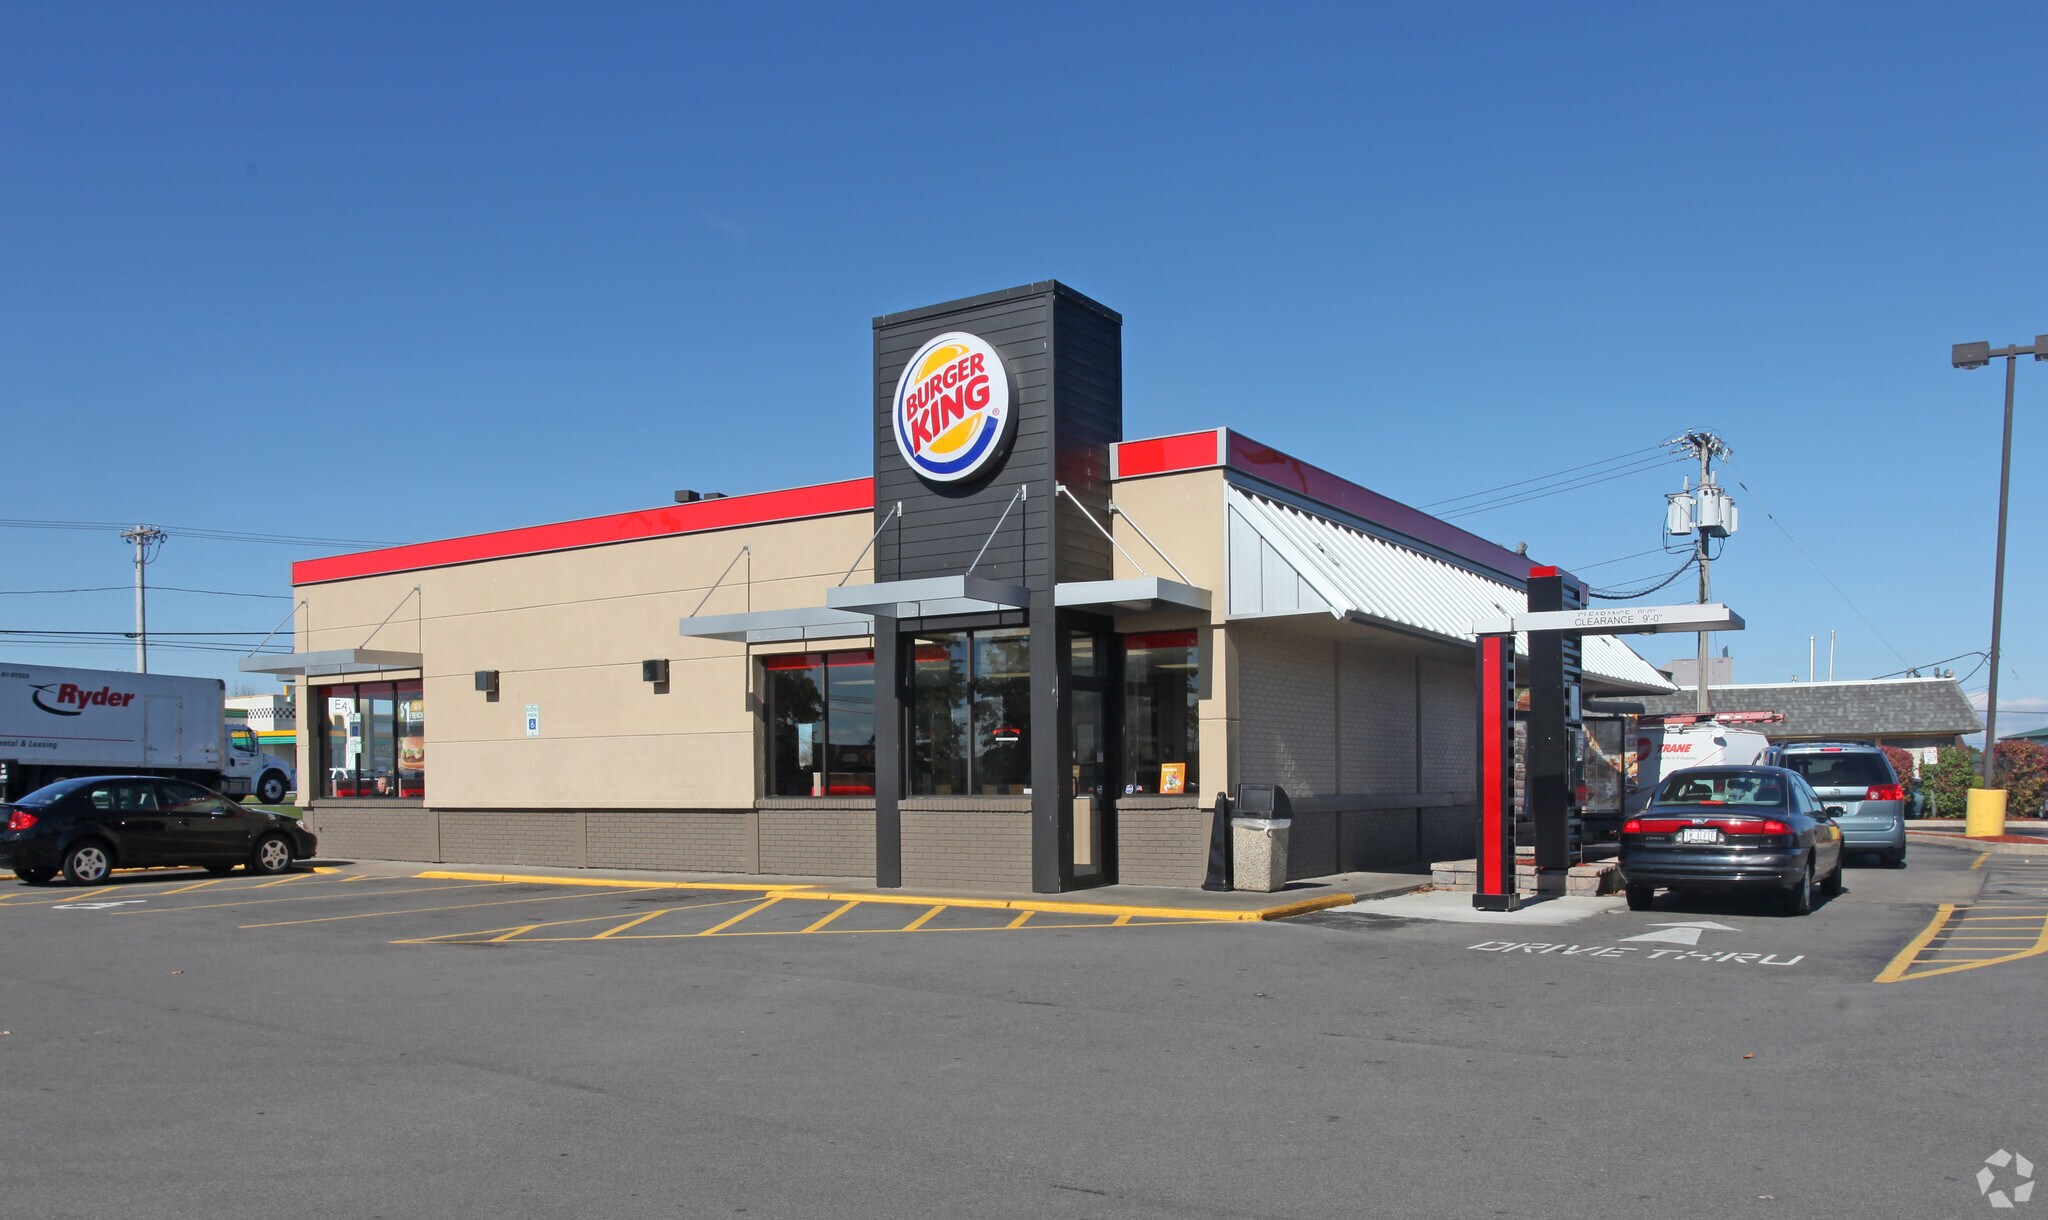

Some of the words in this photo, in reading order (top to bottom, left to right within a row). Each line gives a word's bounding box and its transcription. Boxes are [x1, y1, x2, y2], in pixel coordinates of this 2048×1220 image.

[907, 352, 985, 422] BURGER
[911, 374, 990, 456] KING
[1575, 615, 1634, 627] CLEARANCE
[57, 683, 135, 709] Ryder
[20, 740, 26, 748] &
[28, 740, 58, 750] Leasing
[1657, 743, 1693, 753] TRANE
[1467, 941, 1639, 957] DRIVE
[1647, 950, 1805, 966] THRU
